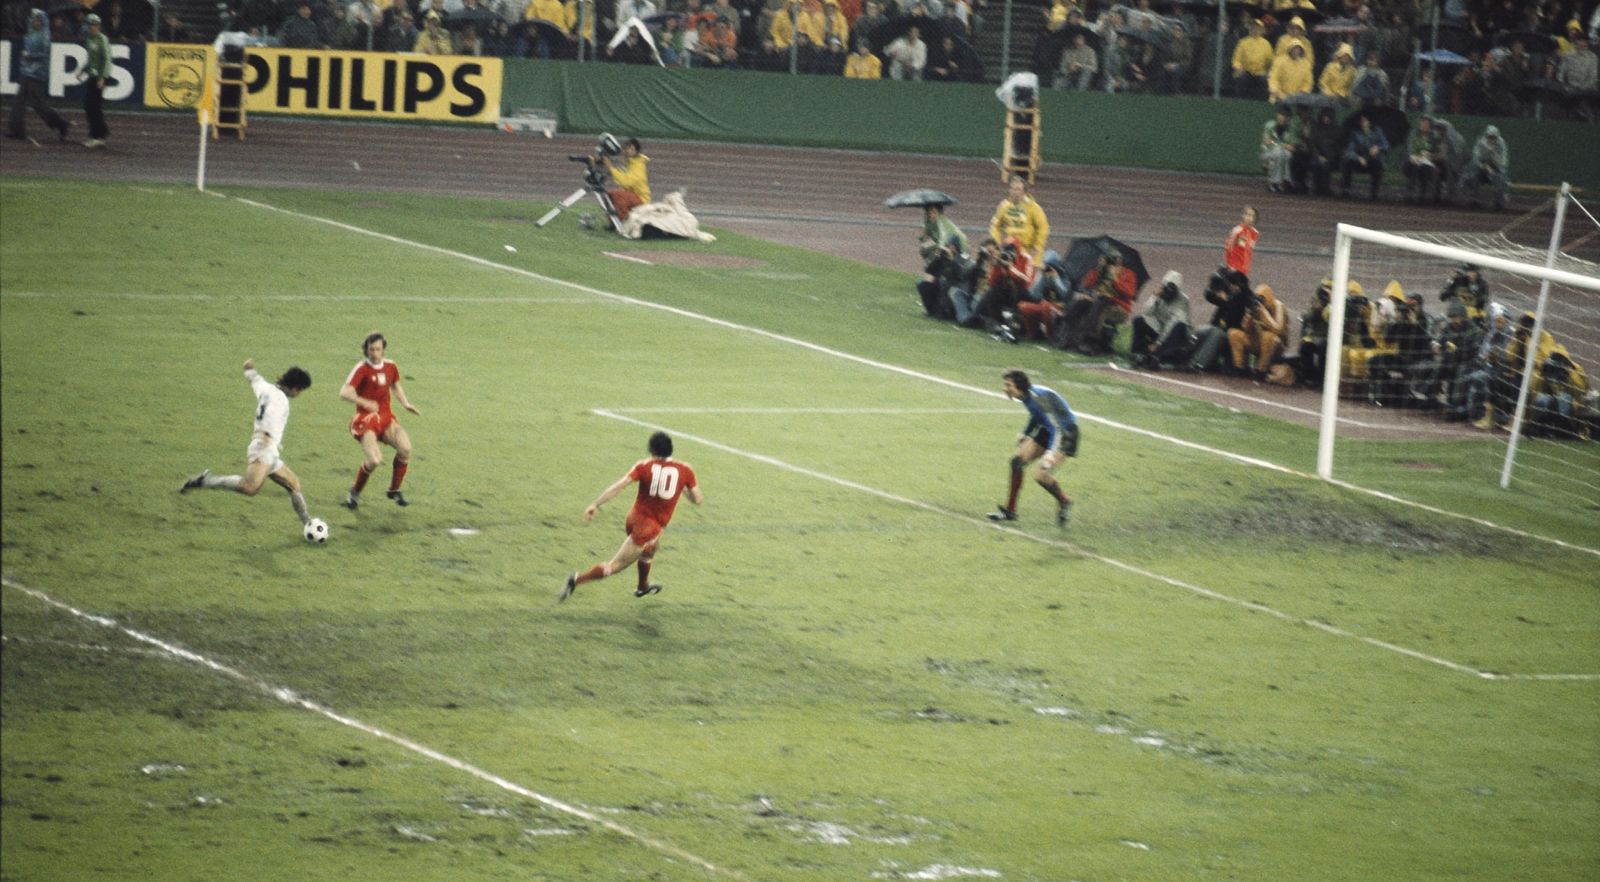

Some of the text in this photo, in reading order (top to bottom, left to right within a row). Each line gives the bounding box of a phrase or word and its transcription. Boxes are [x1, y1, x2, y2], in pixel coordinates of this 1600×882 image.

[0, 40, 135, 100] LPS
[160, 48, 206, 61] PHILIPS
[649, 463, 679, 500] 10
